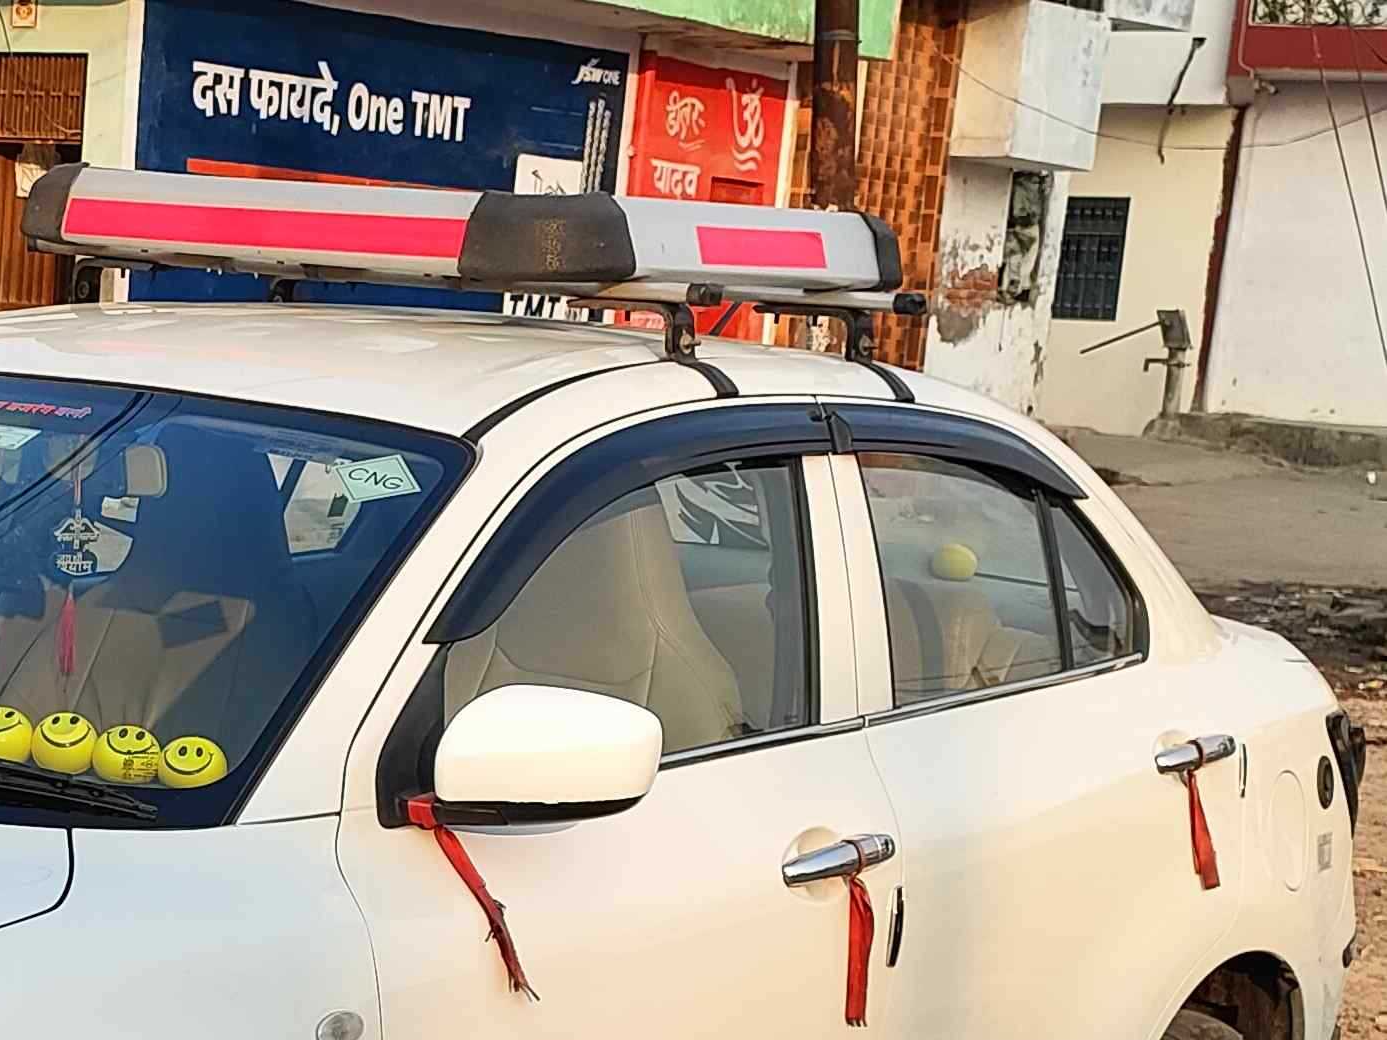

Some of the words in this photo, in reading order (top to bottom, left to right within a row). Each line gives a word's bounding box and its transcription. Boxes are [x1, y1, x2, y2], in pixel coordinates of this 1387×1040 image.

[193, 61, 244, 117] दस
[249, 61, 340, 136] फायदे,
[347, 82, 404, 135] One
[411, 90, 471, 142] TMT
[650, 158, 701, 200] यादव
[510, 294, 561, 319] TMT
[348, 467, 404, 490] CNG
